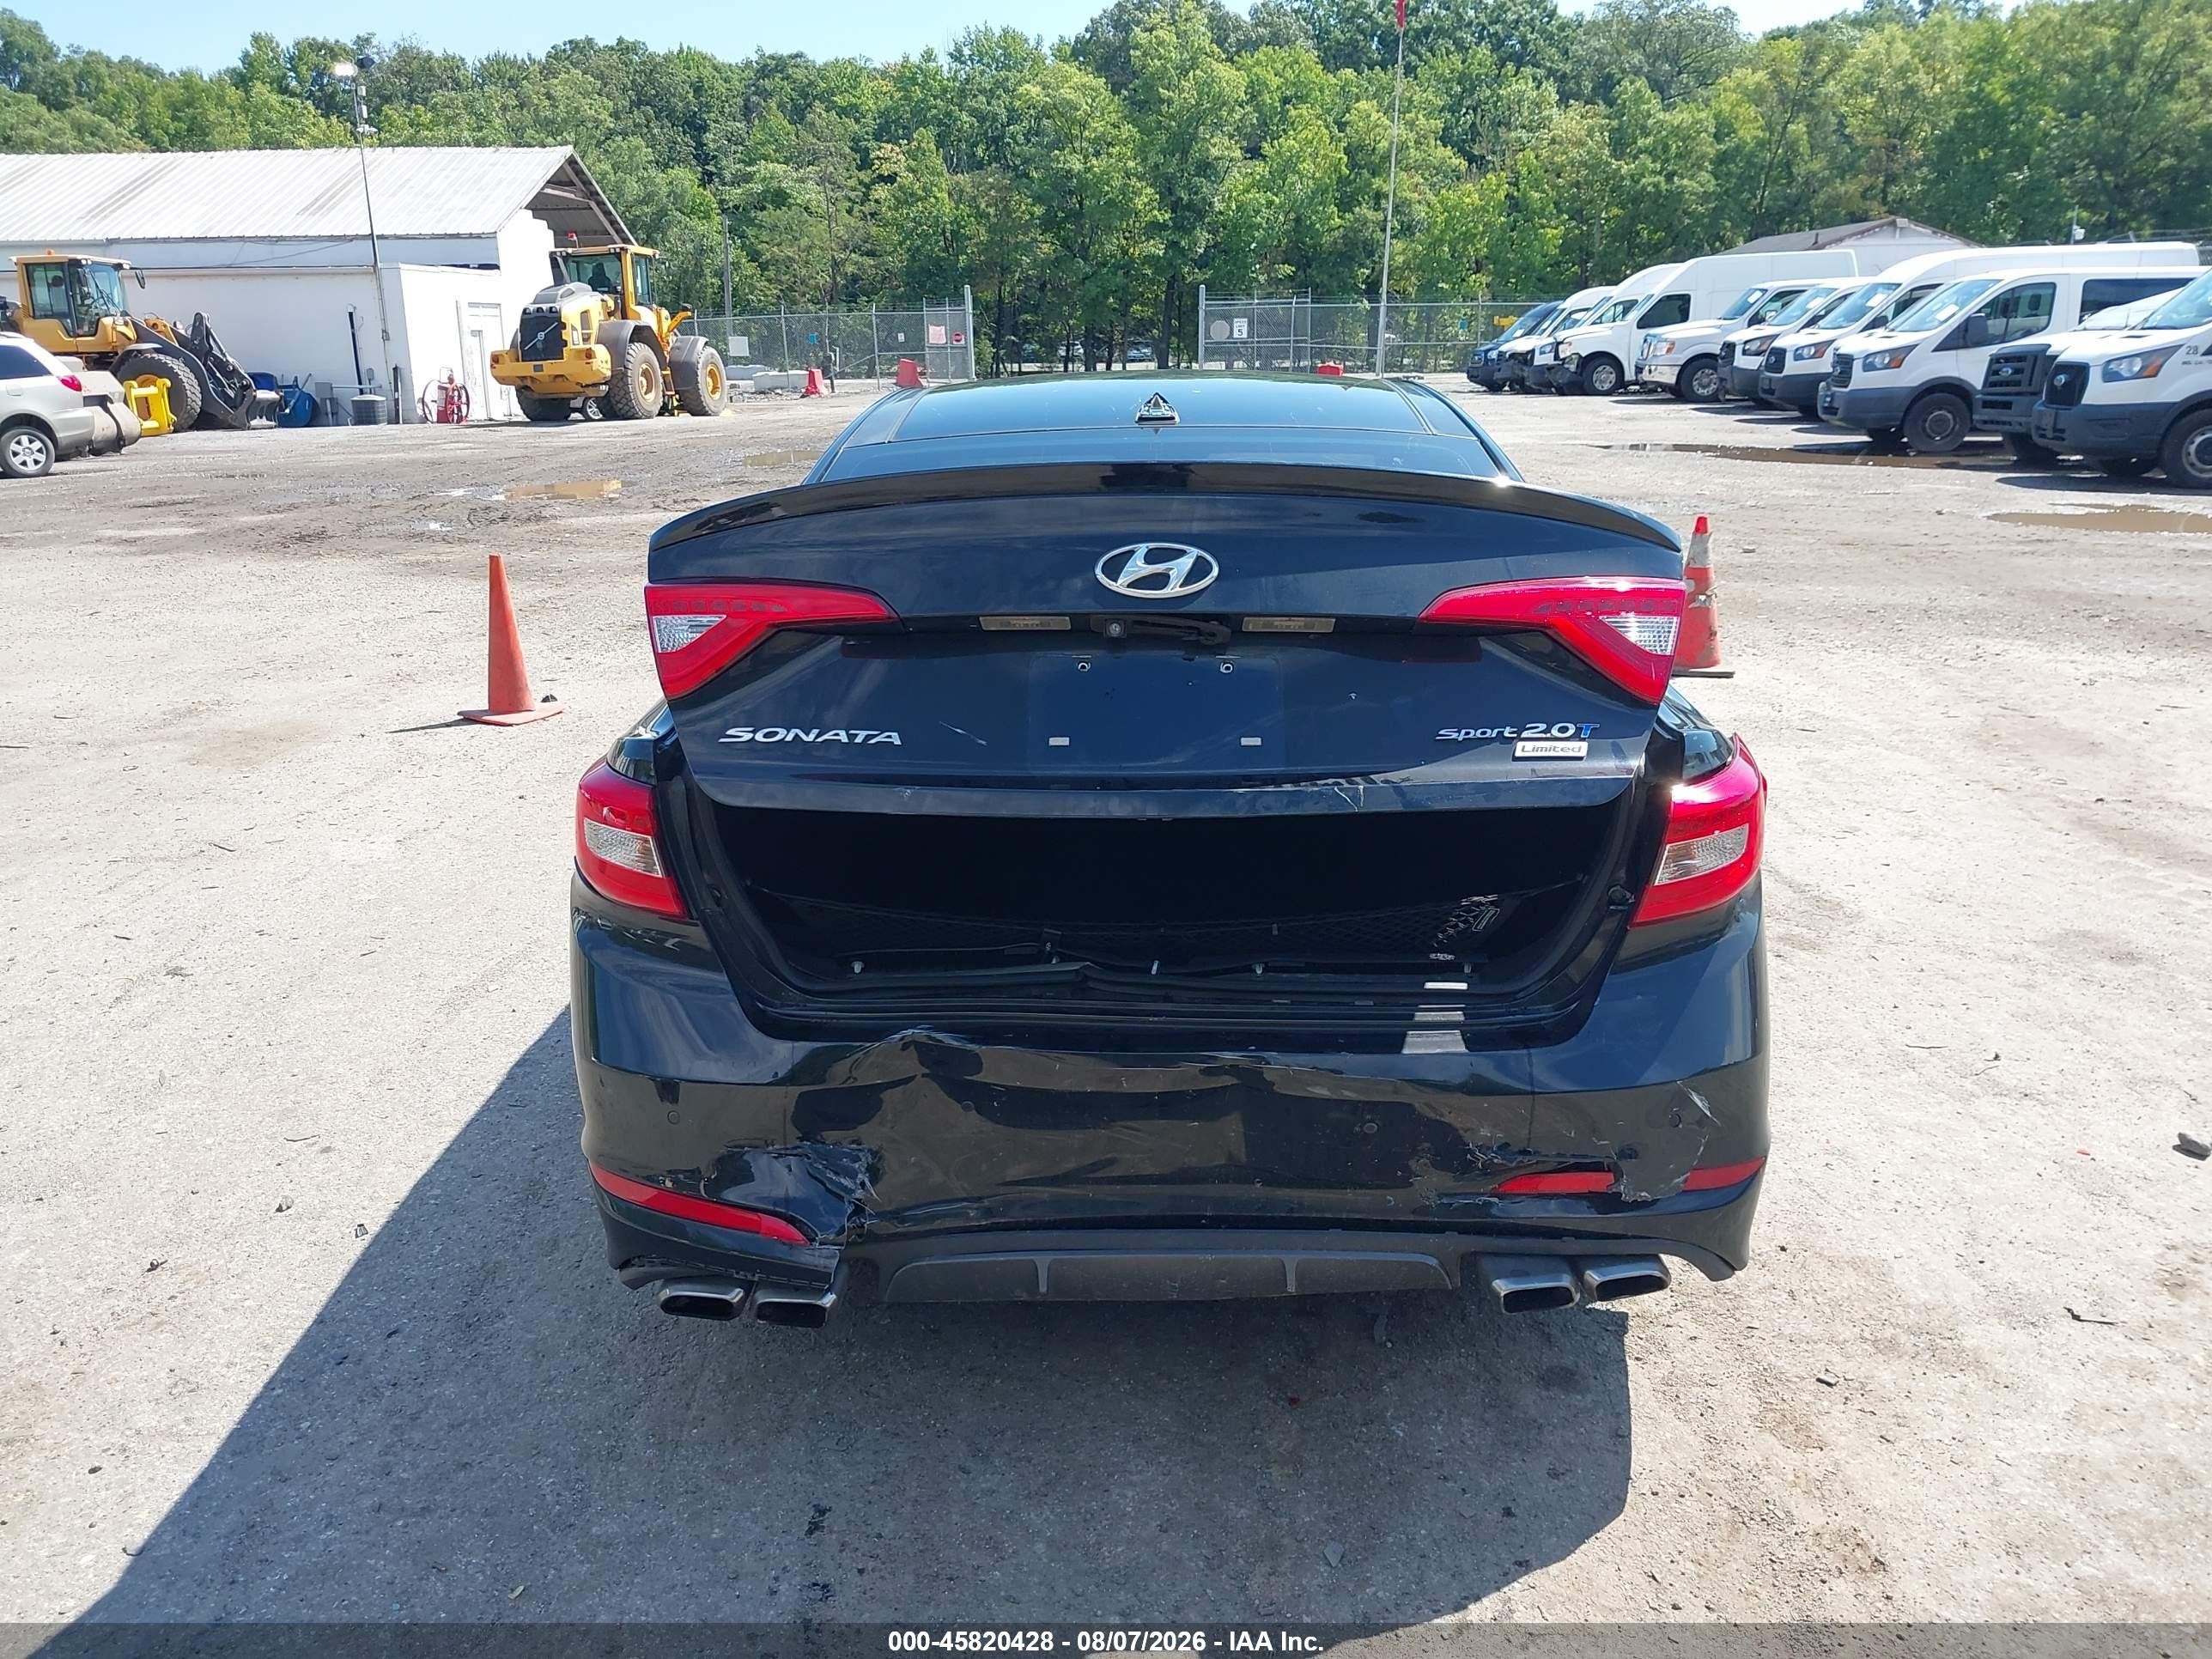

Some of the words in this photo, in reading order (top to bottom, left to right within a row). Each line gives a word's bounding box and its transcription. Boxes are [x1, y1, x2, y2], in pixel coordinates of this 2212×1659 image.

[718, 727, 902, 745] SONATA
[1436, 726, 1518, 741] Sport
[1520, 723, 1600, 738] 2.0T
[1521, 744, 1582, 753] Limited
